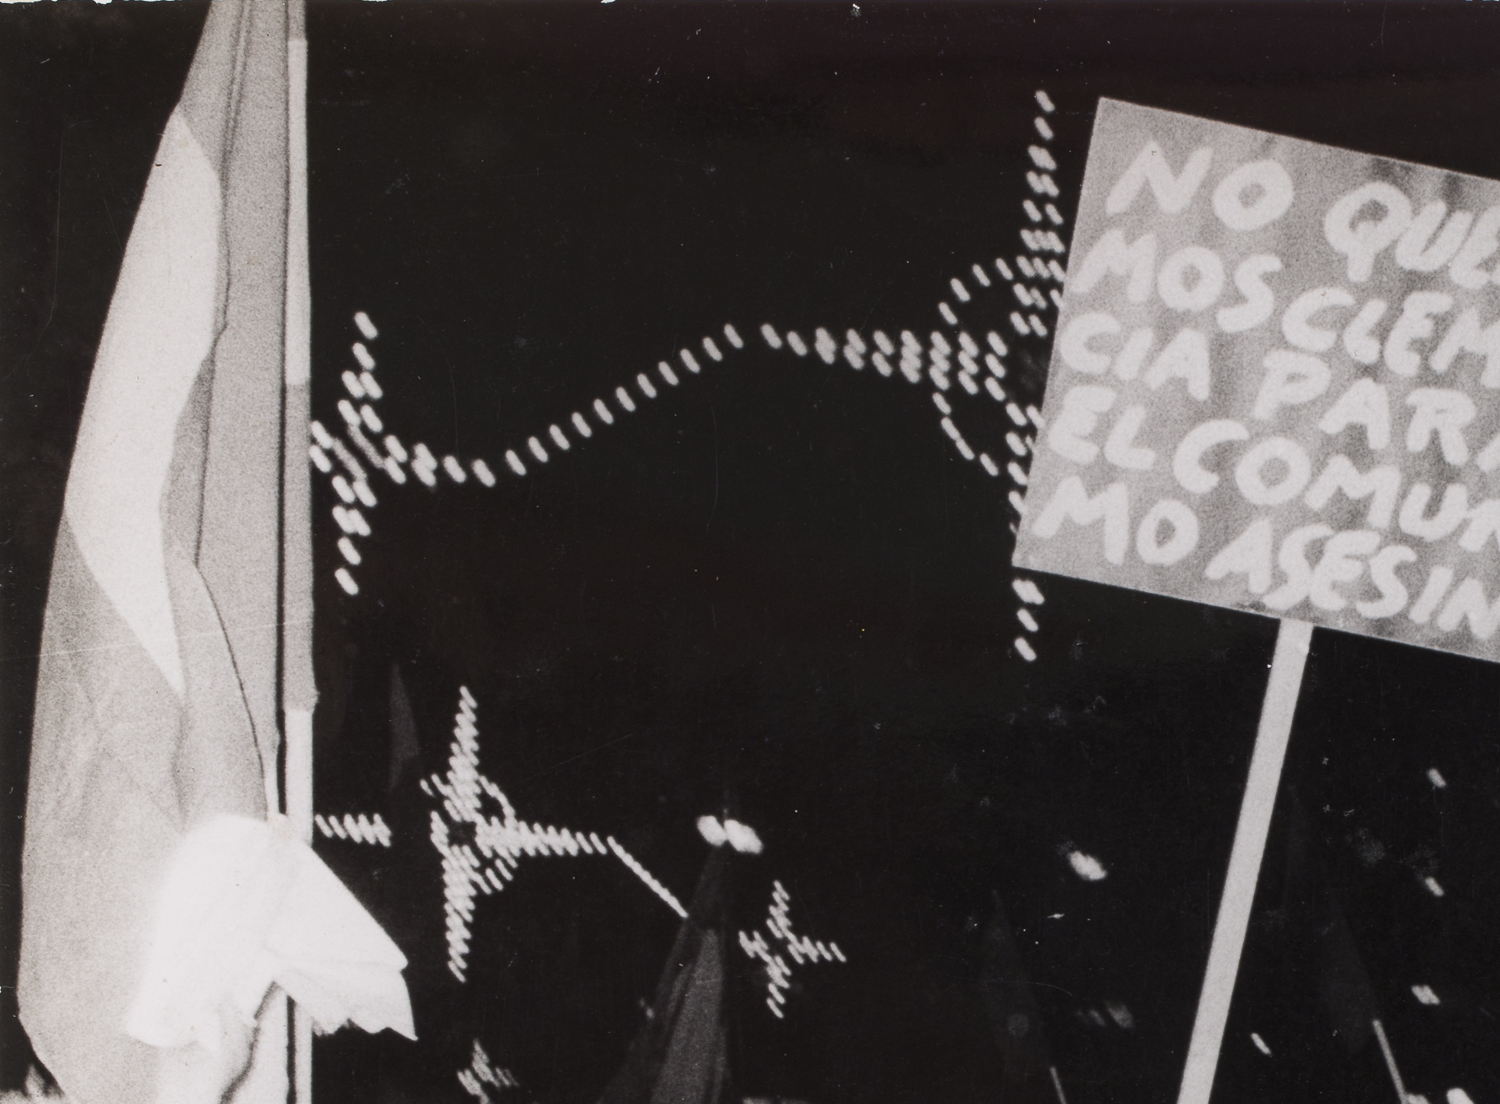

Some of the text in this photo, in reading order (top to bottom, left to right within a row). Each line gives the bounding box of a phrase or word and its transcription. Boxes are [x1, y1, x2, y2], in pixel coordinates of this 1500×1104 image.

[1107, 140, 1295, 232] NO
[1072, 228, 1284, 334] MOS
[1060, 312, 1212, 402] CIA
[1047, 384, 1157, 471] EL
[1034, 474, 1201, 566] MO
